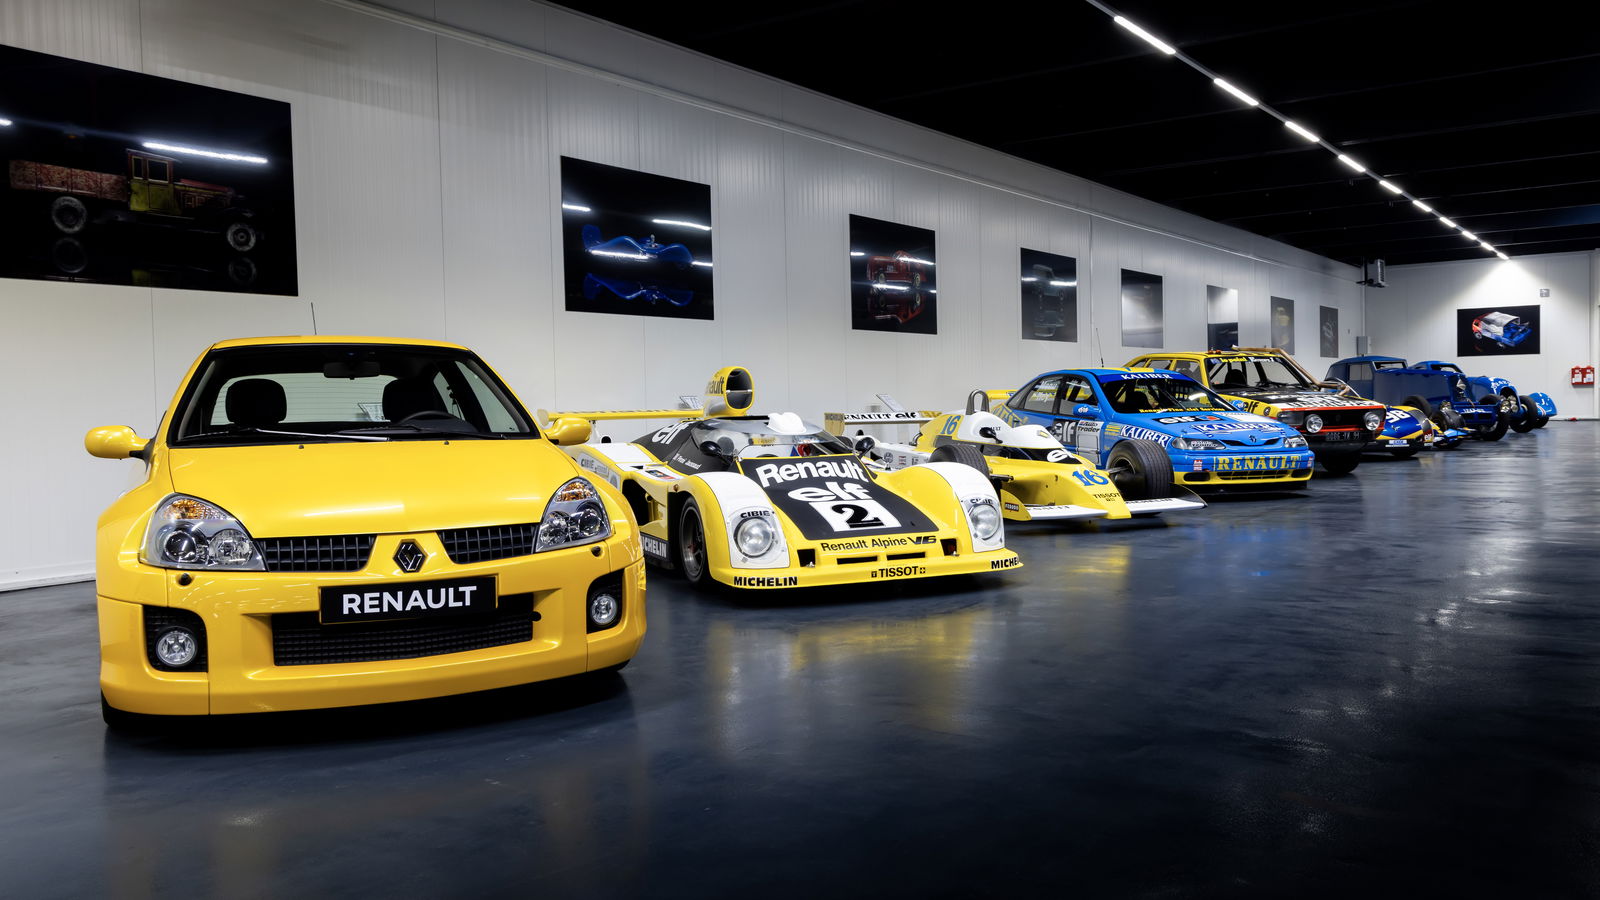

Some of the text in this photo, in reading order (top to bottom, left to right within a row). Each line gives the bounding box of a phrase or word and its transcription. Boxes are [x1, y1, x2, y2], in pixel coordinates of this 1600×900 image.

[940, 415, 961, 435] 16
[1159, 416, 1196, 424] elf
[1199, 422, 1277, 431] KALIBER
[652, 421, 690, 444] elf
[1053, 421, 1077, 443] elf
[1120, 425, 1172, 447] KALIBER
[1217, 456, 1300, 471] RENAULT
[755, 458, 869, 488] Renault
[1071, 470, 1109, 486] 16
[788, 482, 873, 501] elf
[740, 510, 770, 518] CIBIE
[831, 504, 887, 528] 2
[820, 535, 937, 551] Renault Alpine V6
[991, 556, 1018, 569] MICHE
[878, 566, 919, 578] TISSOT
[733, 575, 798, 587] MICHELIN
[342, 585, 477, 615] RENAULT
